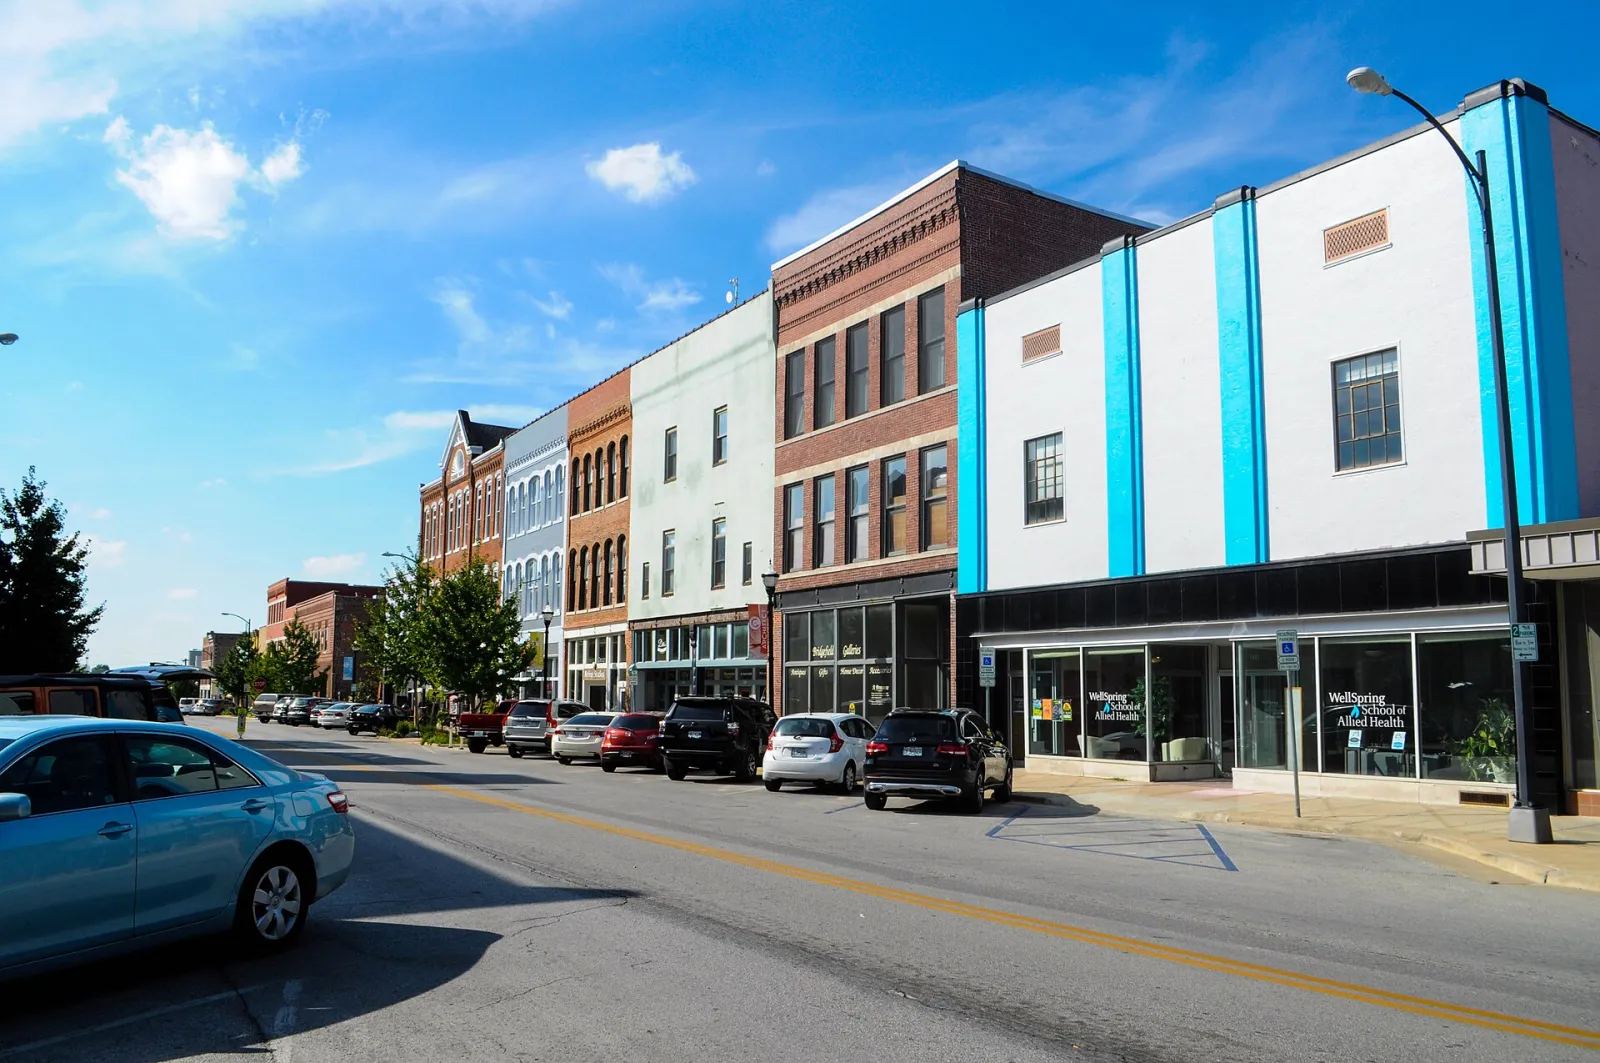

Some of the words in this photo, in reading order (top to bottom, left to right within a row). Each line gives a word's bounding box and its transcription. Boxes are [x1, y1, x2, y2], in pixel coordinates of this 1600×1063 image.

[1512, 626, 1519, 636] 2
[842, 643, 862, 658] Galleries
[840, 667, 852, 675] Home
[1088, 691, 1128, 704] WellSpring
[1328, 691, 1386, 706] WellSpring
[1110, 702, 1134, 711] School
[1134, 703, 1141, 711] of
[1361, 703, 1395, 716] School
[1397, 705, 1407, 715] of
[1095, 710, 1115, 721] Allied
[1116, 711, 1139, 721] Health
[1337, 714, 1368, 727] Allied
[1369, 716, 1404, 728] Health
